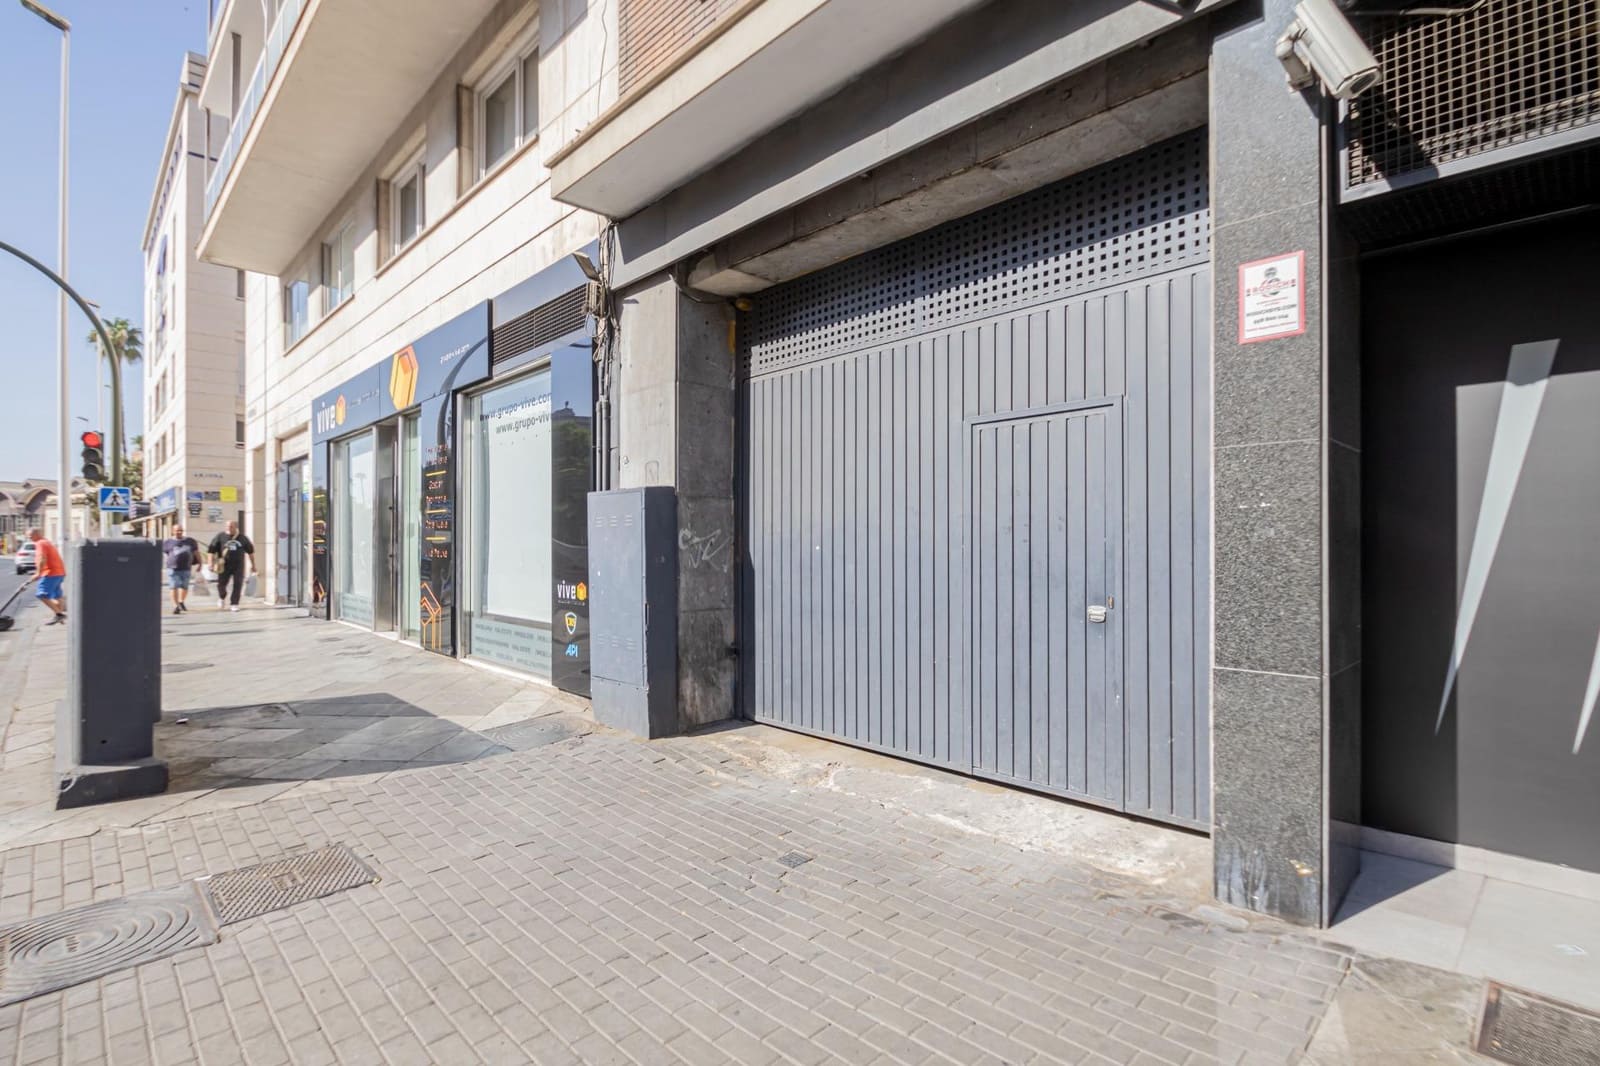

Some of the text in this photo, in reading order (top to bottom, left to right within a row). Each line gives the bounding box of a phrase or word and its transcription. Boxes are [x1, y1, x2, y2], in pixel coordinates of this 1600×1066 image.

[317, 401, 336, 435] vive
[557, 579, 576, 600] vive
[565, 644, 578, 658] API
